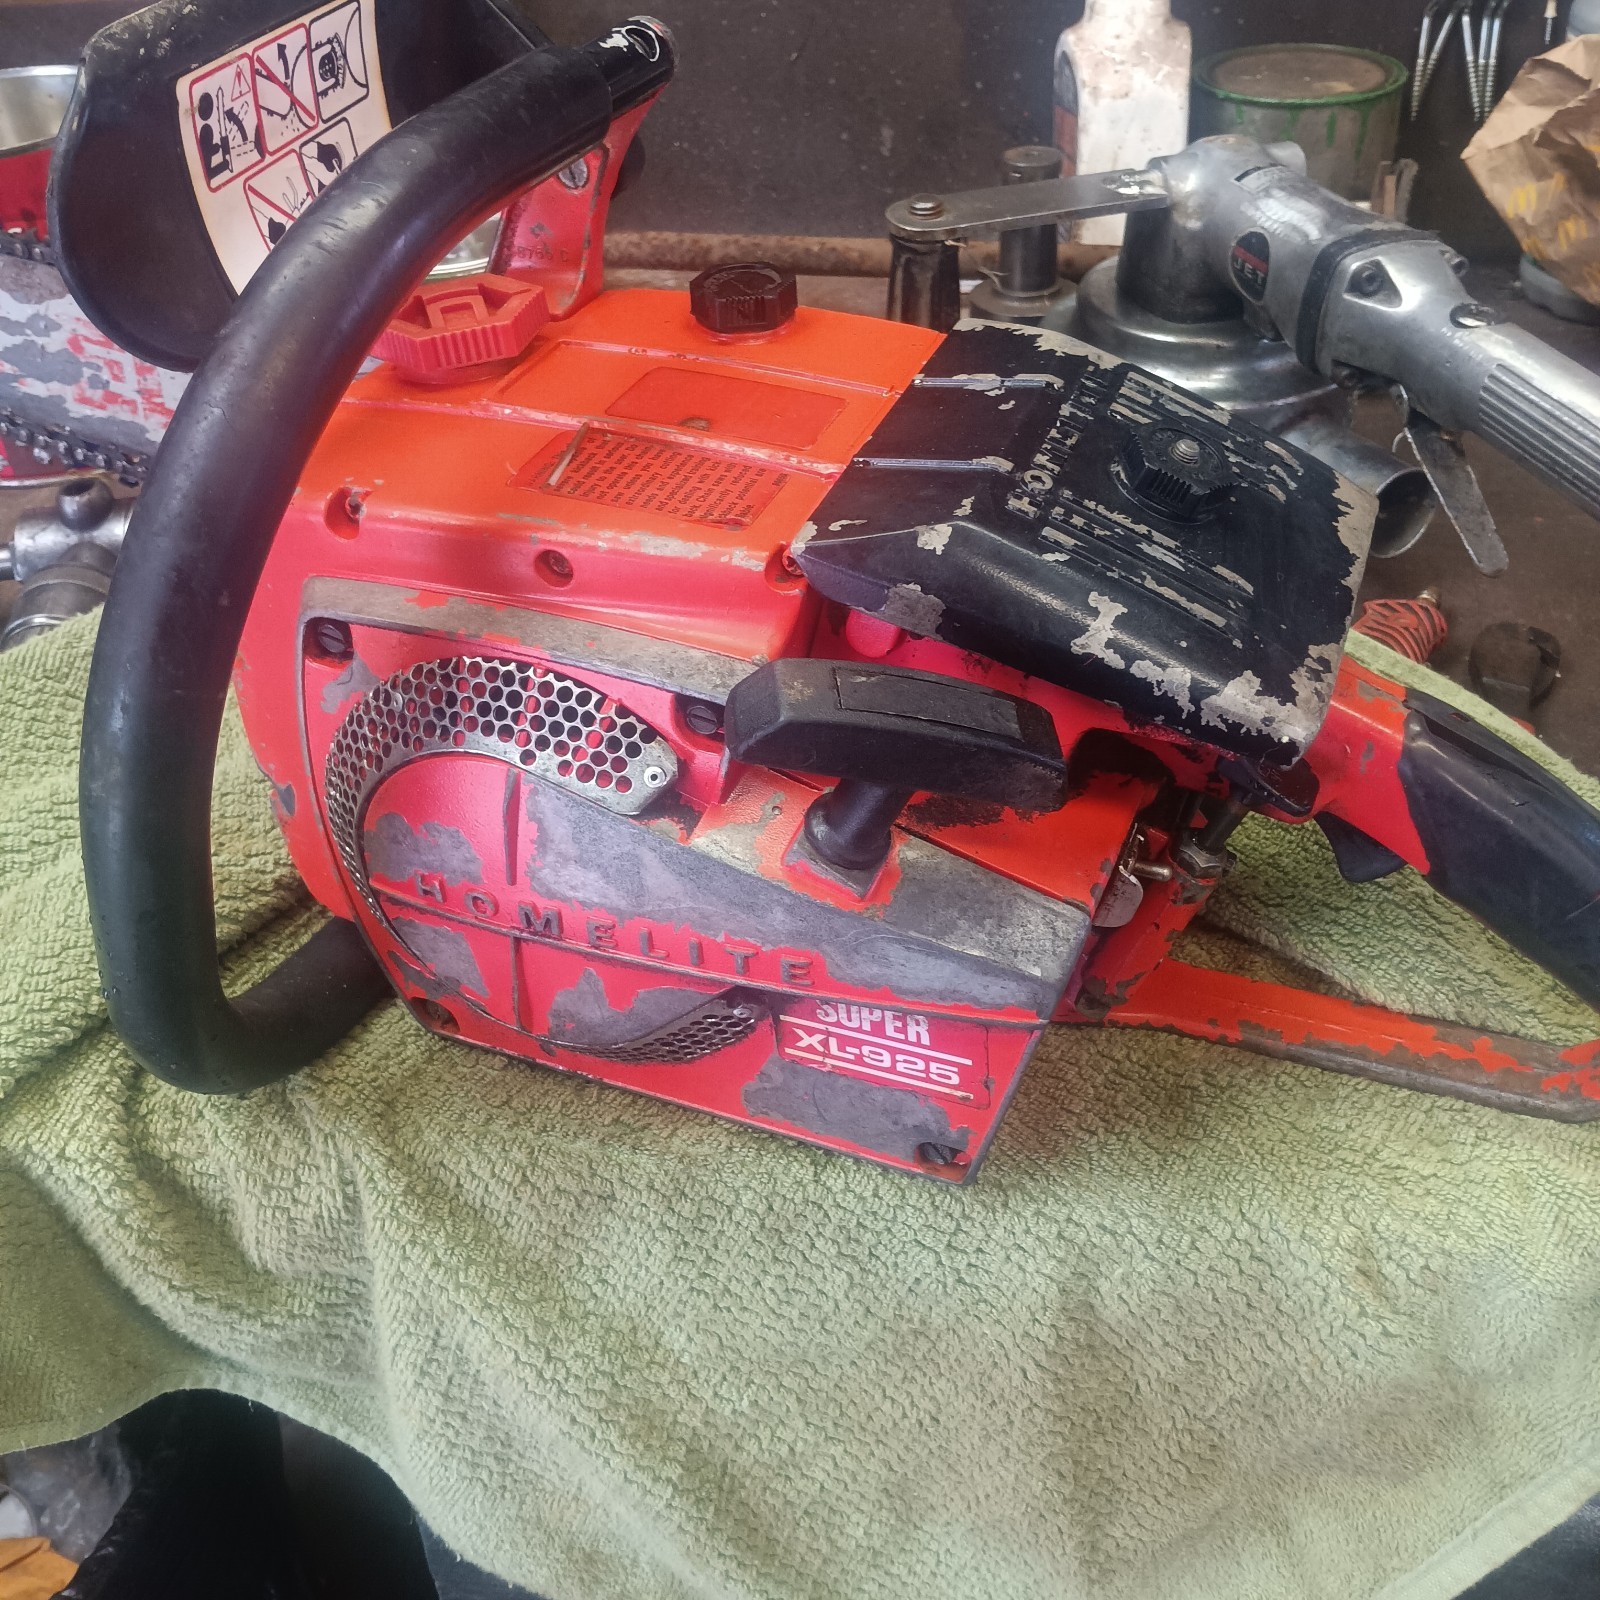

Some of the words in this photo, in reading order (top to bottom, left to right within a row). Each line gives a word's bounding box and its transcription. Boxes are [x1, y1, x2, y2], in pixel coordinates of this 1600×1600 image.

[1233, 256, 1265, 285] JET
[593, 490, 610, 499] not
[604, 470, 629, 490] operate
[622, 460, 638, 470] this
[601, 465, 617, 474] the
[620, 473, 643, 490] unless
[638, 461, 655, 472] you
[648, 448, 666, 460] have
[623, 471, 663, 506] extraordinary
[656, 450, 683, 470] cutting
[636, 492, 659, 508] needs
[653, 480, 670, 491] and
[664, 453, 697, 480] experience
[651, 500, 669, 511] and
[661, 474, 695, 501] specialized
[685, 456, 712, 475] training
[726, 464, 752, 485] reduced
[732, 477, 761, 500] potential
[753, 468, 767, 477] are
[666, 505, 682, 514] for
[675, 485, 703, 505] dealing
[694, 487, 716, 502] Chain
[414, 868, 814, 986] HOMELITE
[815, 1000, 931, 1046] SUPER
[792, 1027, 960, 1085] XL-925
